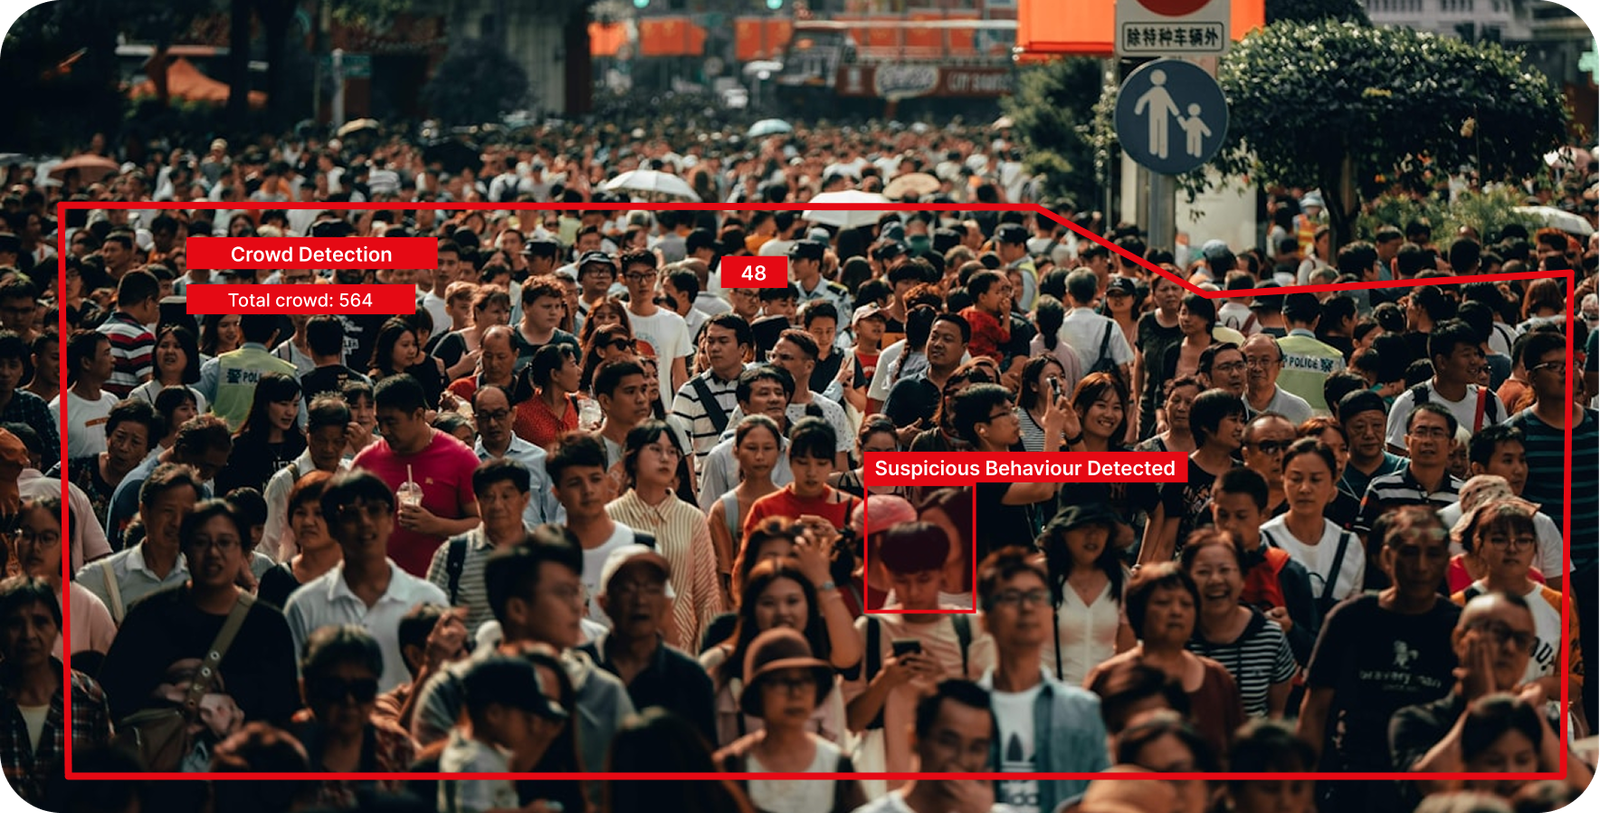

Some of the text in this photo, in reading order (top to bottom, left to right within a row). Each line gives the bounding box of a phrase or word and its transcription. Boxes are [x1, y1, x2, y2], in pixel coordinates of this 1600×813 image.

[1126, 27, 1218, 47] 除特种车辆外
[1289, 357, 1319, 370] POLICE
[243, 371, 259, 383] POL
